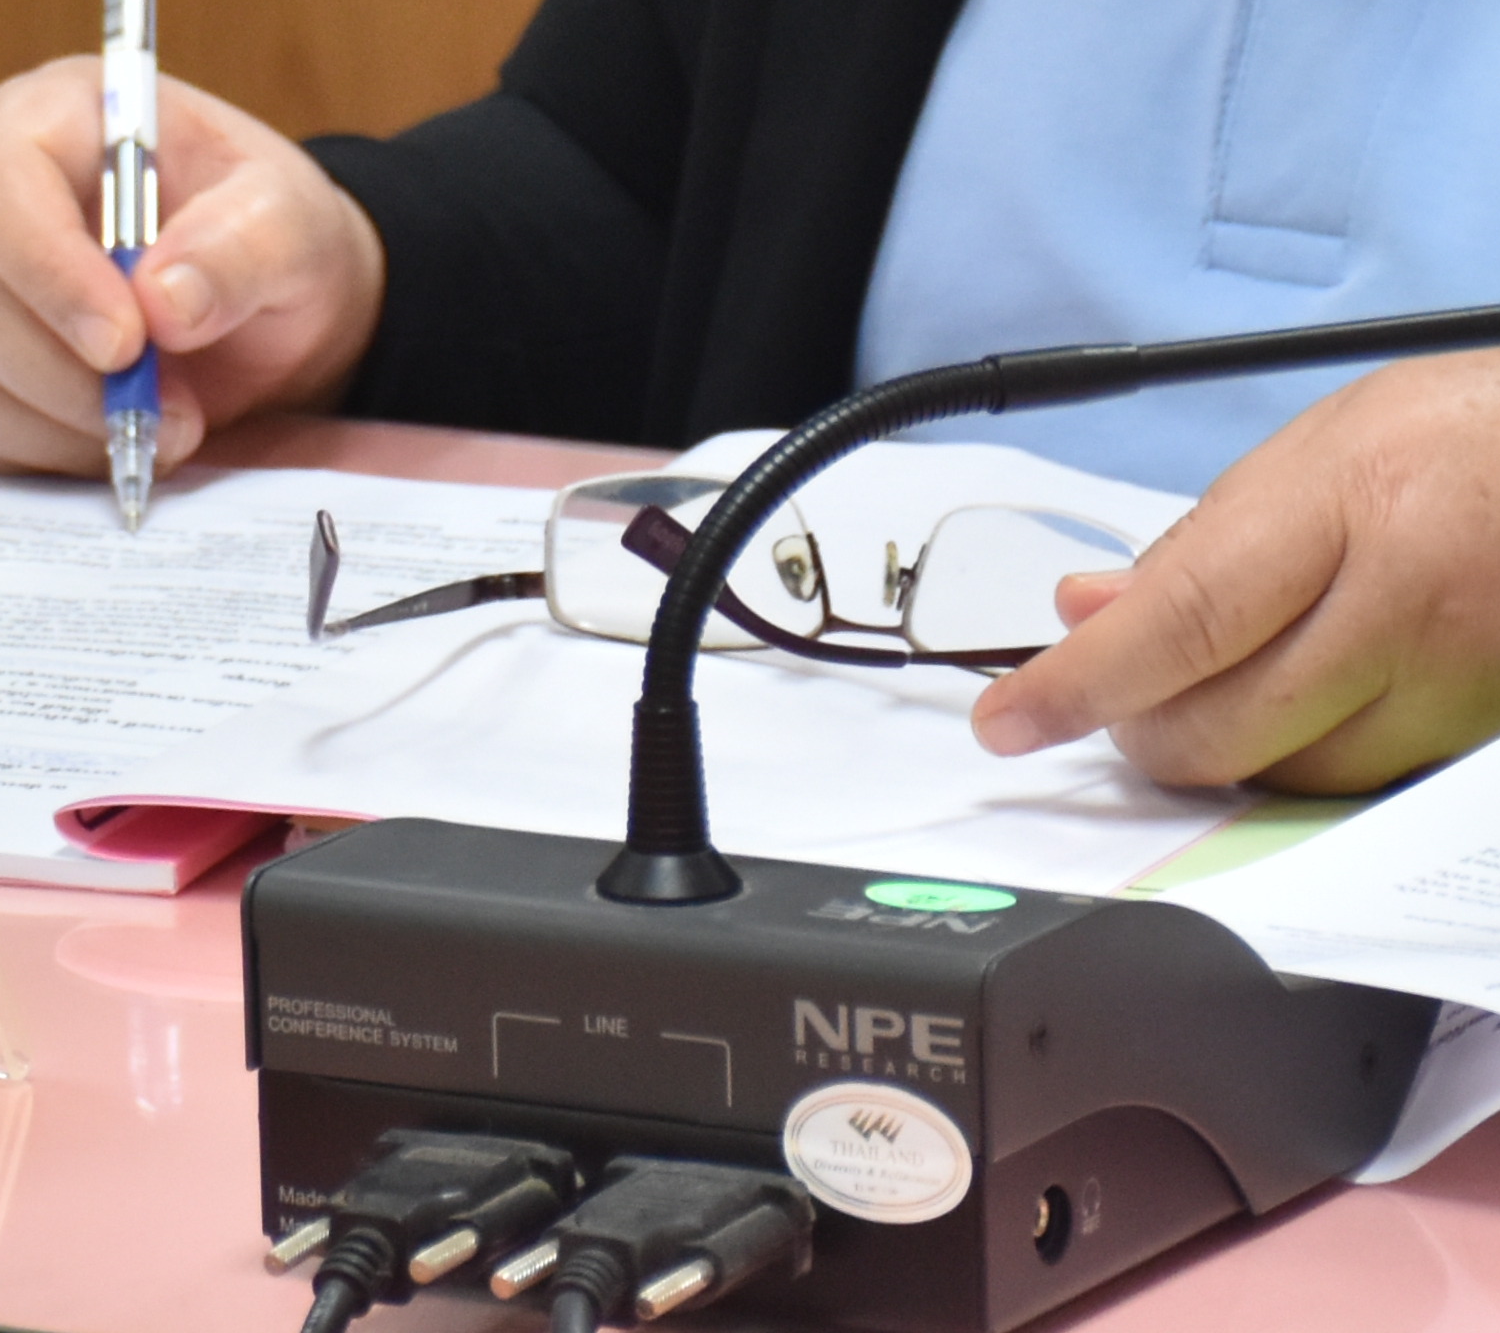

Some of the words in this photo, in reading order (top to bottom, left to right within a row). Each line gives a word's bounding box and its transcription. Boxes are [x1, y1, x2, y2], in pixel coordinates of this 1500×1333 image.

[267, 994, 397, 1027] PROFESSIONAL
[583, 1014, 629, 1039] LINE
[267, 1015, 384, 1045] CONFERENCE
[390, 1030, 459, 1053] SYSTEM
[793, 998, 966, 1067] NPE
[794, 1049, 968, 1085] RESEARCH
[277, 1184, 329, 1208] Made
